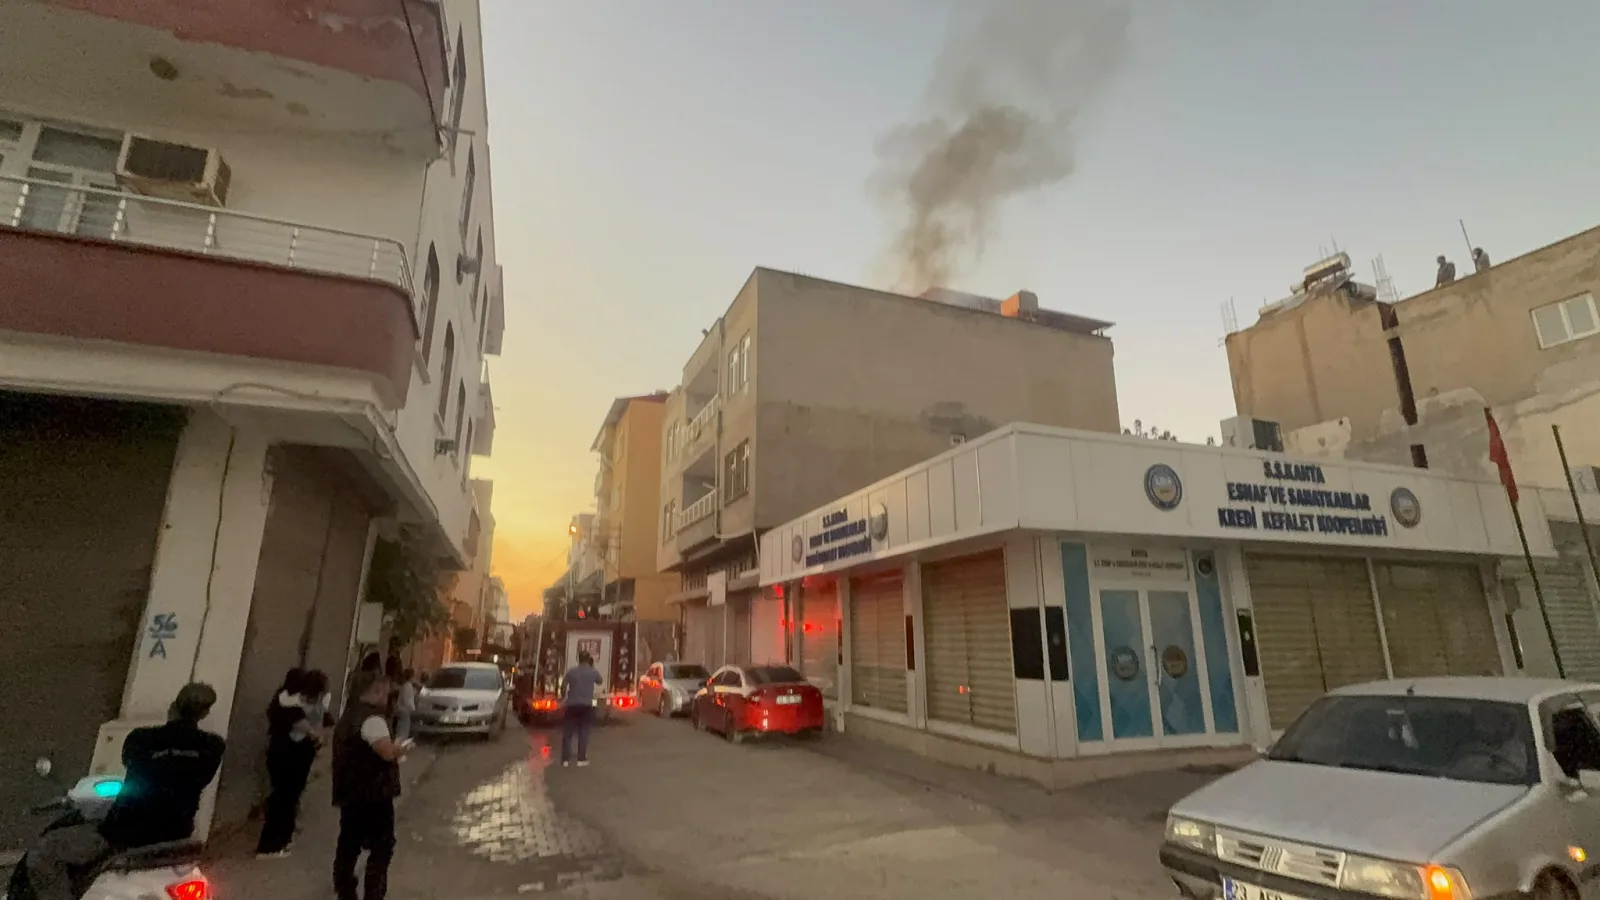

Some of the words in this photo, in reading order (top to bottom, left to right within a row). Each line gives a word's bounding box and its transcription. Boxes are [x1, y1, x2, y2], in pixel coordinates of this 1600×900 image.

[1227, 481, 1268, 503] ESNAF
[1268, 485, 1287, 505] VE
[1217, 505, 1257, 528] KREDİ
[1261, 511, 1315, 533] KEFALET
[149, 612, 178, 632] 56
[149, 639, 166, 659] A
